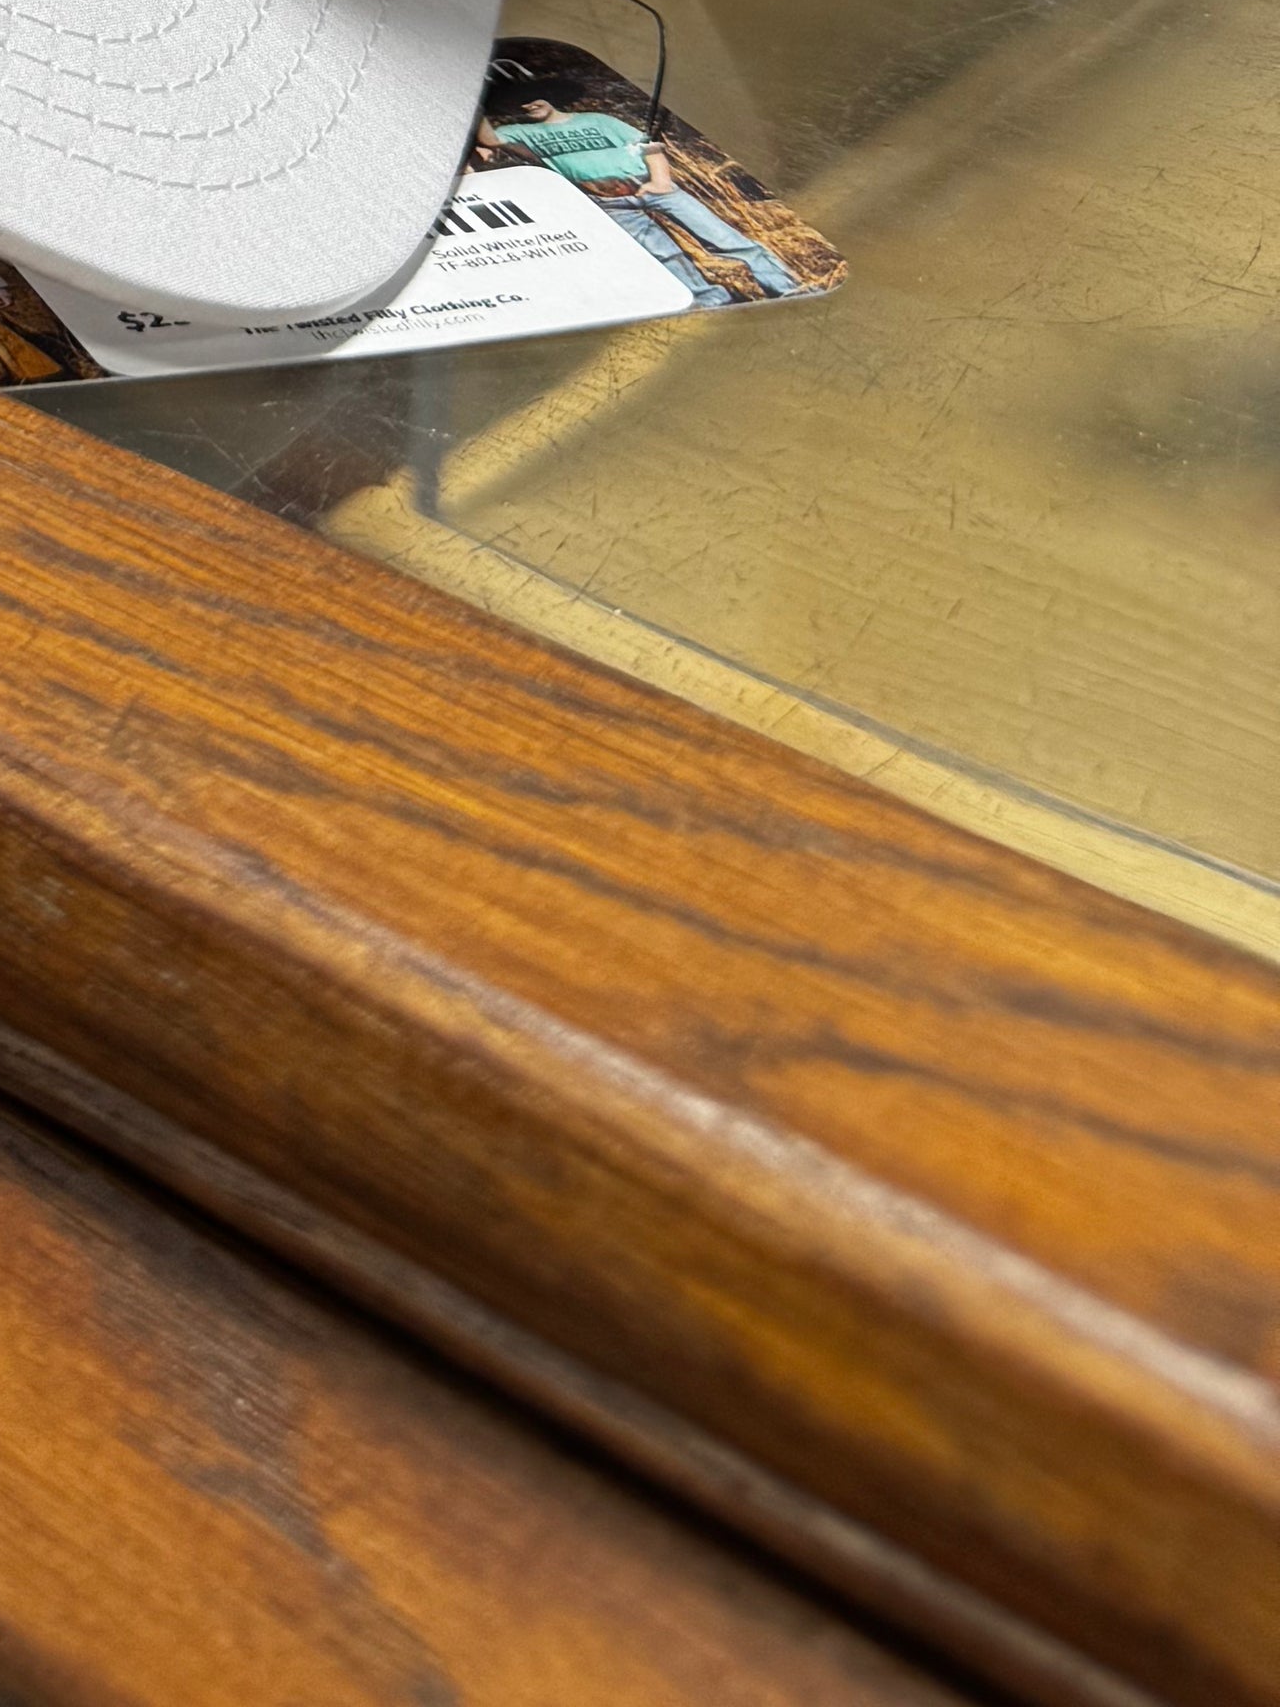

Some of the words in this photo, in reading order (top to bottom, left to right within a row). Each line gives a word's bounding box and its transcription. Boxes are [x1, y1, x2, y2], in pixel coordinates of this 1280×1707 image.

[431, 243, 477, 261] Solid
[481, 229, 578, 258] White/Red
[362, 307, 407, 320] Filly
[409, 297, 498, 315] Clothing
[495, 293, 530, 304] Co.
[310, 312, 486, 340] thetwistedfilly.com
